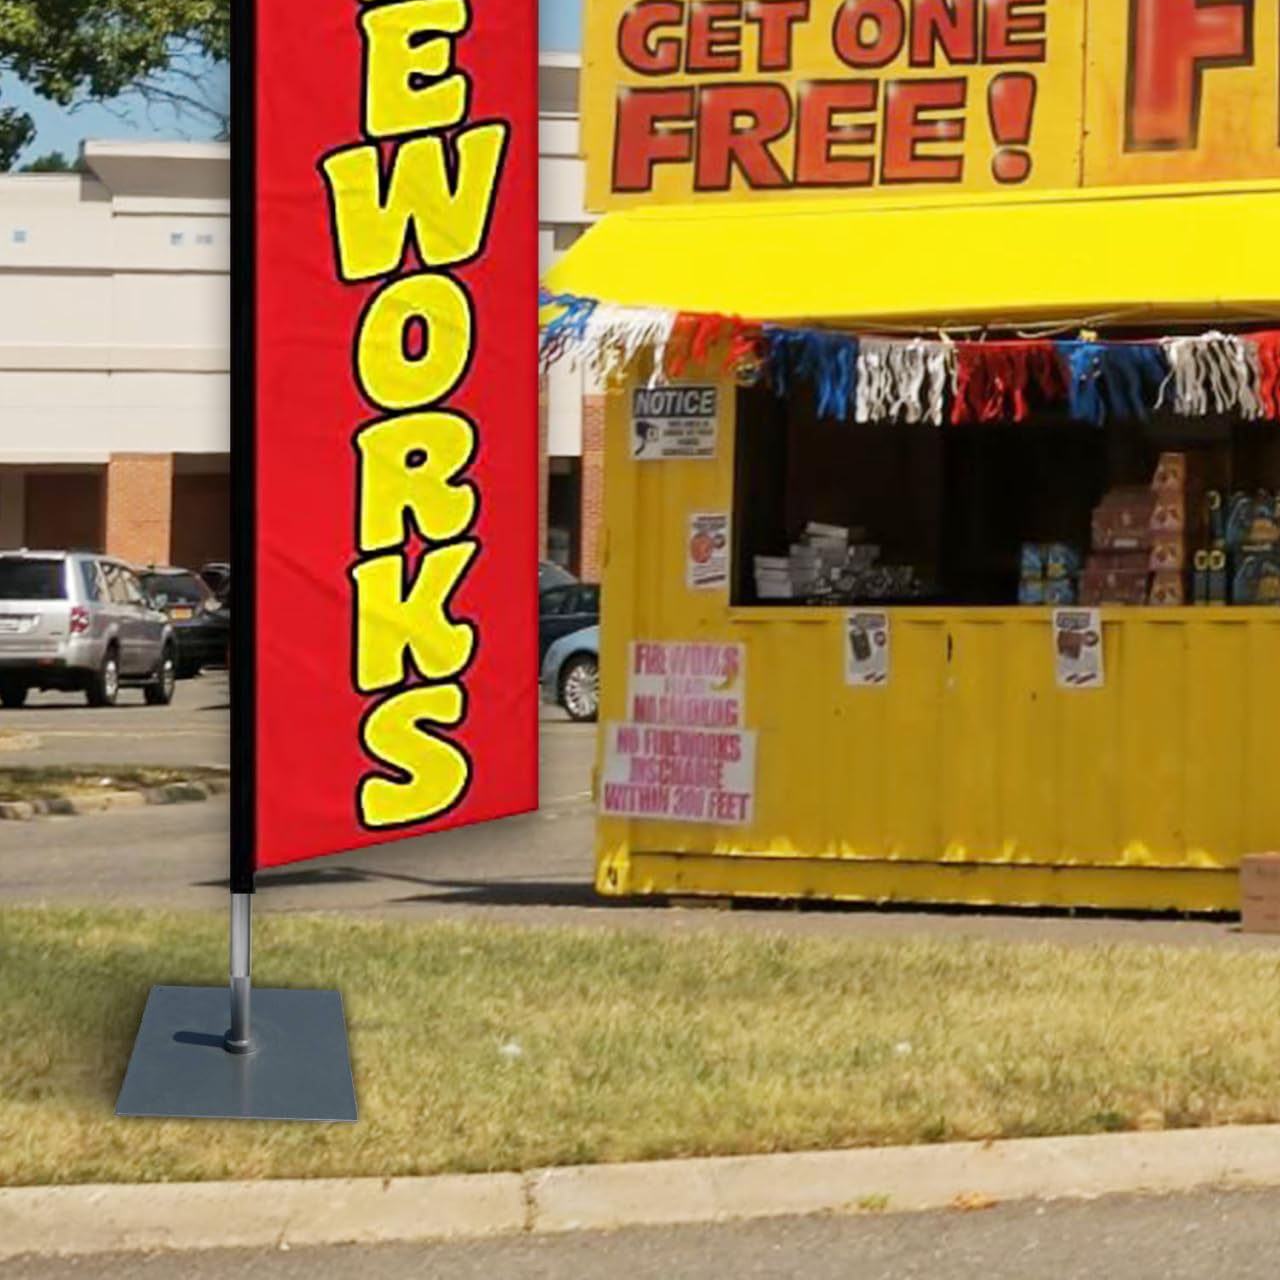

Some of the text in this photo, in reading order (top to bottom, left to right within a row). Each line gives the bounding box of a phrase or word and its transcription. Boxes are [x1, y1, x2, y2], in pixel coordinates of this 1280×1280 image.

[610, 71, 1037, 194] FREE!
[635, 390, 715, 416] NOTICE
[708, 790, 751, 821] FEET
